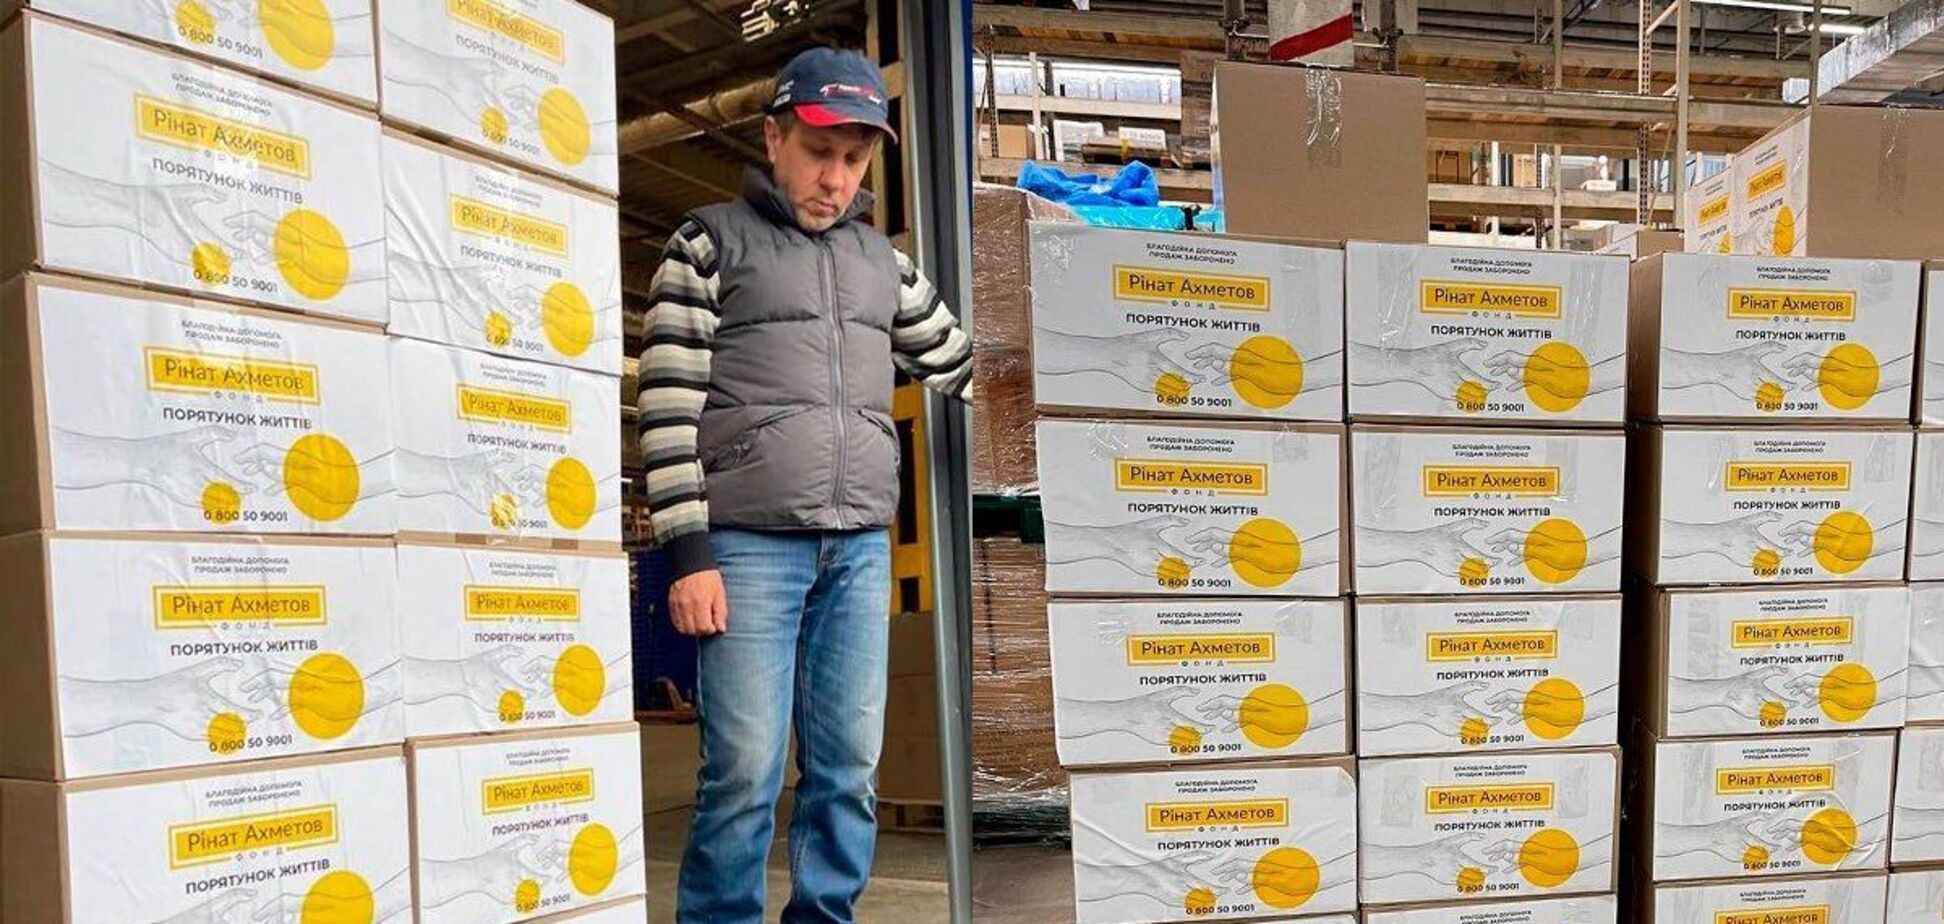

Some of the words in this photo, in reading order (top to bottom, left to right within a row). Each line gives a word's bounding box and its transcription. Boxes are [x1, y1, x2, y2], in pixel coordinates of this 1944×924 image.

[153, 109, 206, 141] Рінат
[211, 122, 296, 163] Ахметов
[153, 158, 246, 192] ПОРЯТУНОК
[249, 177, 302, 203] ЖИТТІВ
[1129, 274, 1175, 293] Рінат
[1181, 278, 1255, 299] Ахметов
[1434, 288, 1475, 304] Рінат
[1480, 290, 1548, 307] Ахметов
[1740, 296, 1777, 310] Рінат
[1781, 297, 1844, 311] Ахметов
[1126, 313, 1207, 329] ПОРЯТУНОК
[1210, 318, 1260, 332] ЖИТТІВ
[1431, 325, 1504, 338] ПОРЯТУНОК
[1507, 328, 1552, 339] ЖИТТІВ
[1736, 330, 1802, 340] ПОРЯТУНОК
[1805, 331, 1846, 341] ЖИТТІВ
[165, 358, 216, 382] Рінат
[222, 364, 303, 391] Ахметов
[1156, 394, 1164, 404] 0
[1190, 396, 1204, 406] 50
[1206, 396, 1232, 407] 9001
[1457, 401, 1464, 411] 0
[1487, 402, 1499, 412] 50
[1502, 403, 1524, 412] 9001
[164, 408, 255, 426] ПОРЯТУНОК
[259, 413, 312, 429] ЖИТТІВ
[1130, 466, 1175, 482] Рінат
[1181, 467, 1253, 484] Ахметов
[1437, 473, 1475, 487] Рінат
[1480, 473, 1547, 487] Ахметов
[1738, 468, 1774, 481] Рінат
[1778, 468, 1838, 481] Ахметов
[1128, 503, 1206, 515] ПОРЯТУНОК
[1210, 505, 1258, 516] ЖИТТІВ
[1434, 507, 1504, 516] ПОРЯТУНОК
[1506, 507, 1550, 516] ЖИТТІВ
[1734, 501, 1797, 510] ПОРЯТУНОК
[1800, 500, 1840, 510] ЖИТТІВ
[204, 510, 212, 521] 0
[242, 511, 256, 522] 50
[260, 511, 287, 522] 9001
[1158, 578, 1166, 587] 0
[1190, 579, 1204, 587] 50
[1207, 579, 1231, 587] 9001
[1460, 578, 1466, 586] 0
[1489, 577, 1500, 586] 50
[1503, 577, 1525, 586] 9001
[173, 596, 223, 613] Рінат
[229, 595, 310, 613] Ахметов
[1744, 625, 1778, 639] Рінат
[1782, 623, 1841, 638] Ахметов
[171, 641, 262, 656] ПОРЯТУНОК
[265, 639, 318, 653] ЖИТТІВ
[1142, 640, 1186, 656] Рінат
[1190, 638, 1260, 655] Ахметов
[1440, 638, 1478, 652] Рінат
[1482, 636, 1545, 651] Ахметов
[1740, 655, 1802, 665] ПОРЯТУНОК
[1804, 654, 1844, 664] ЖИТТІВ
[1140, 674, 1216, 685] ПОРЯТУНОК
[1218, 673, 1266, 683] ЖИТТІВ
[1437, 669, 1504, 680] ПОРЯТУНОК
[1507, 668, 1549, 678] ЖИТТІВ
[209, 740, 217, 752] 0
[247, 737, 262, 749] 50
[265, 735, 292, 748] 9001
[1728, 773, 1762, 786] Рінат
[1766, 772, 1823, 785] Ахметов
[1438, 791, 1475, 805] Рінат
[1480, 789, 1542, 804] Ахметов
[1724, 800, 1785, 812] ПОРЯТУНОК
[1787, 799, 1826, 809] ЖИТТІВ
[1160, 808, 1202, 823] Рінат
[1206, 805, 1275, 821] Ахметов
[1435, 821, 1500, 831] ПОРЯТУНОК
[1503, 819, 1545, 829] ЖИТТІВ
[188, 826, 239, 851] Рінат
[245, 815, 323, 843] Ахметов
[1158, 838, 1231, 851] ПОРЯТУНОК
[1234, 837, 1280, 848] ЖИТТІВ
[186, 867, 275, 894] ПОРЯТУНОК
[278, 858, 330, 879] ЖИТТІВ
[1186, 906, 1193, 915] 0
[1216, 905, 1228, 914] 50
[1231, 904, 1255, 913] 9001
